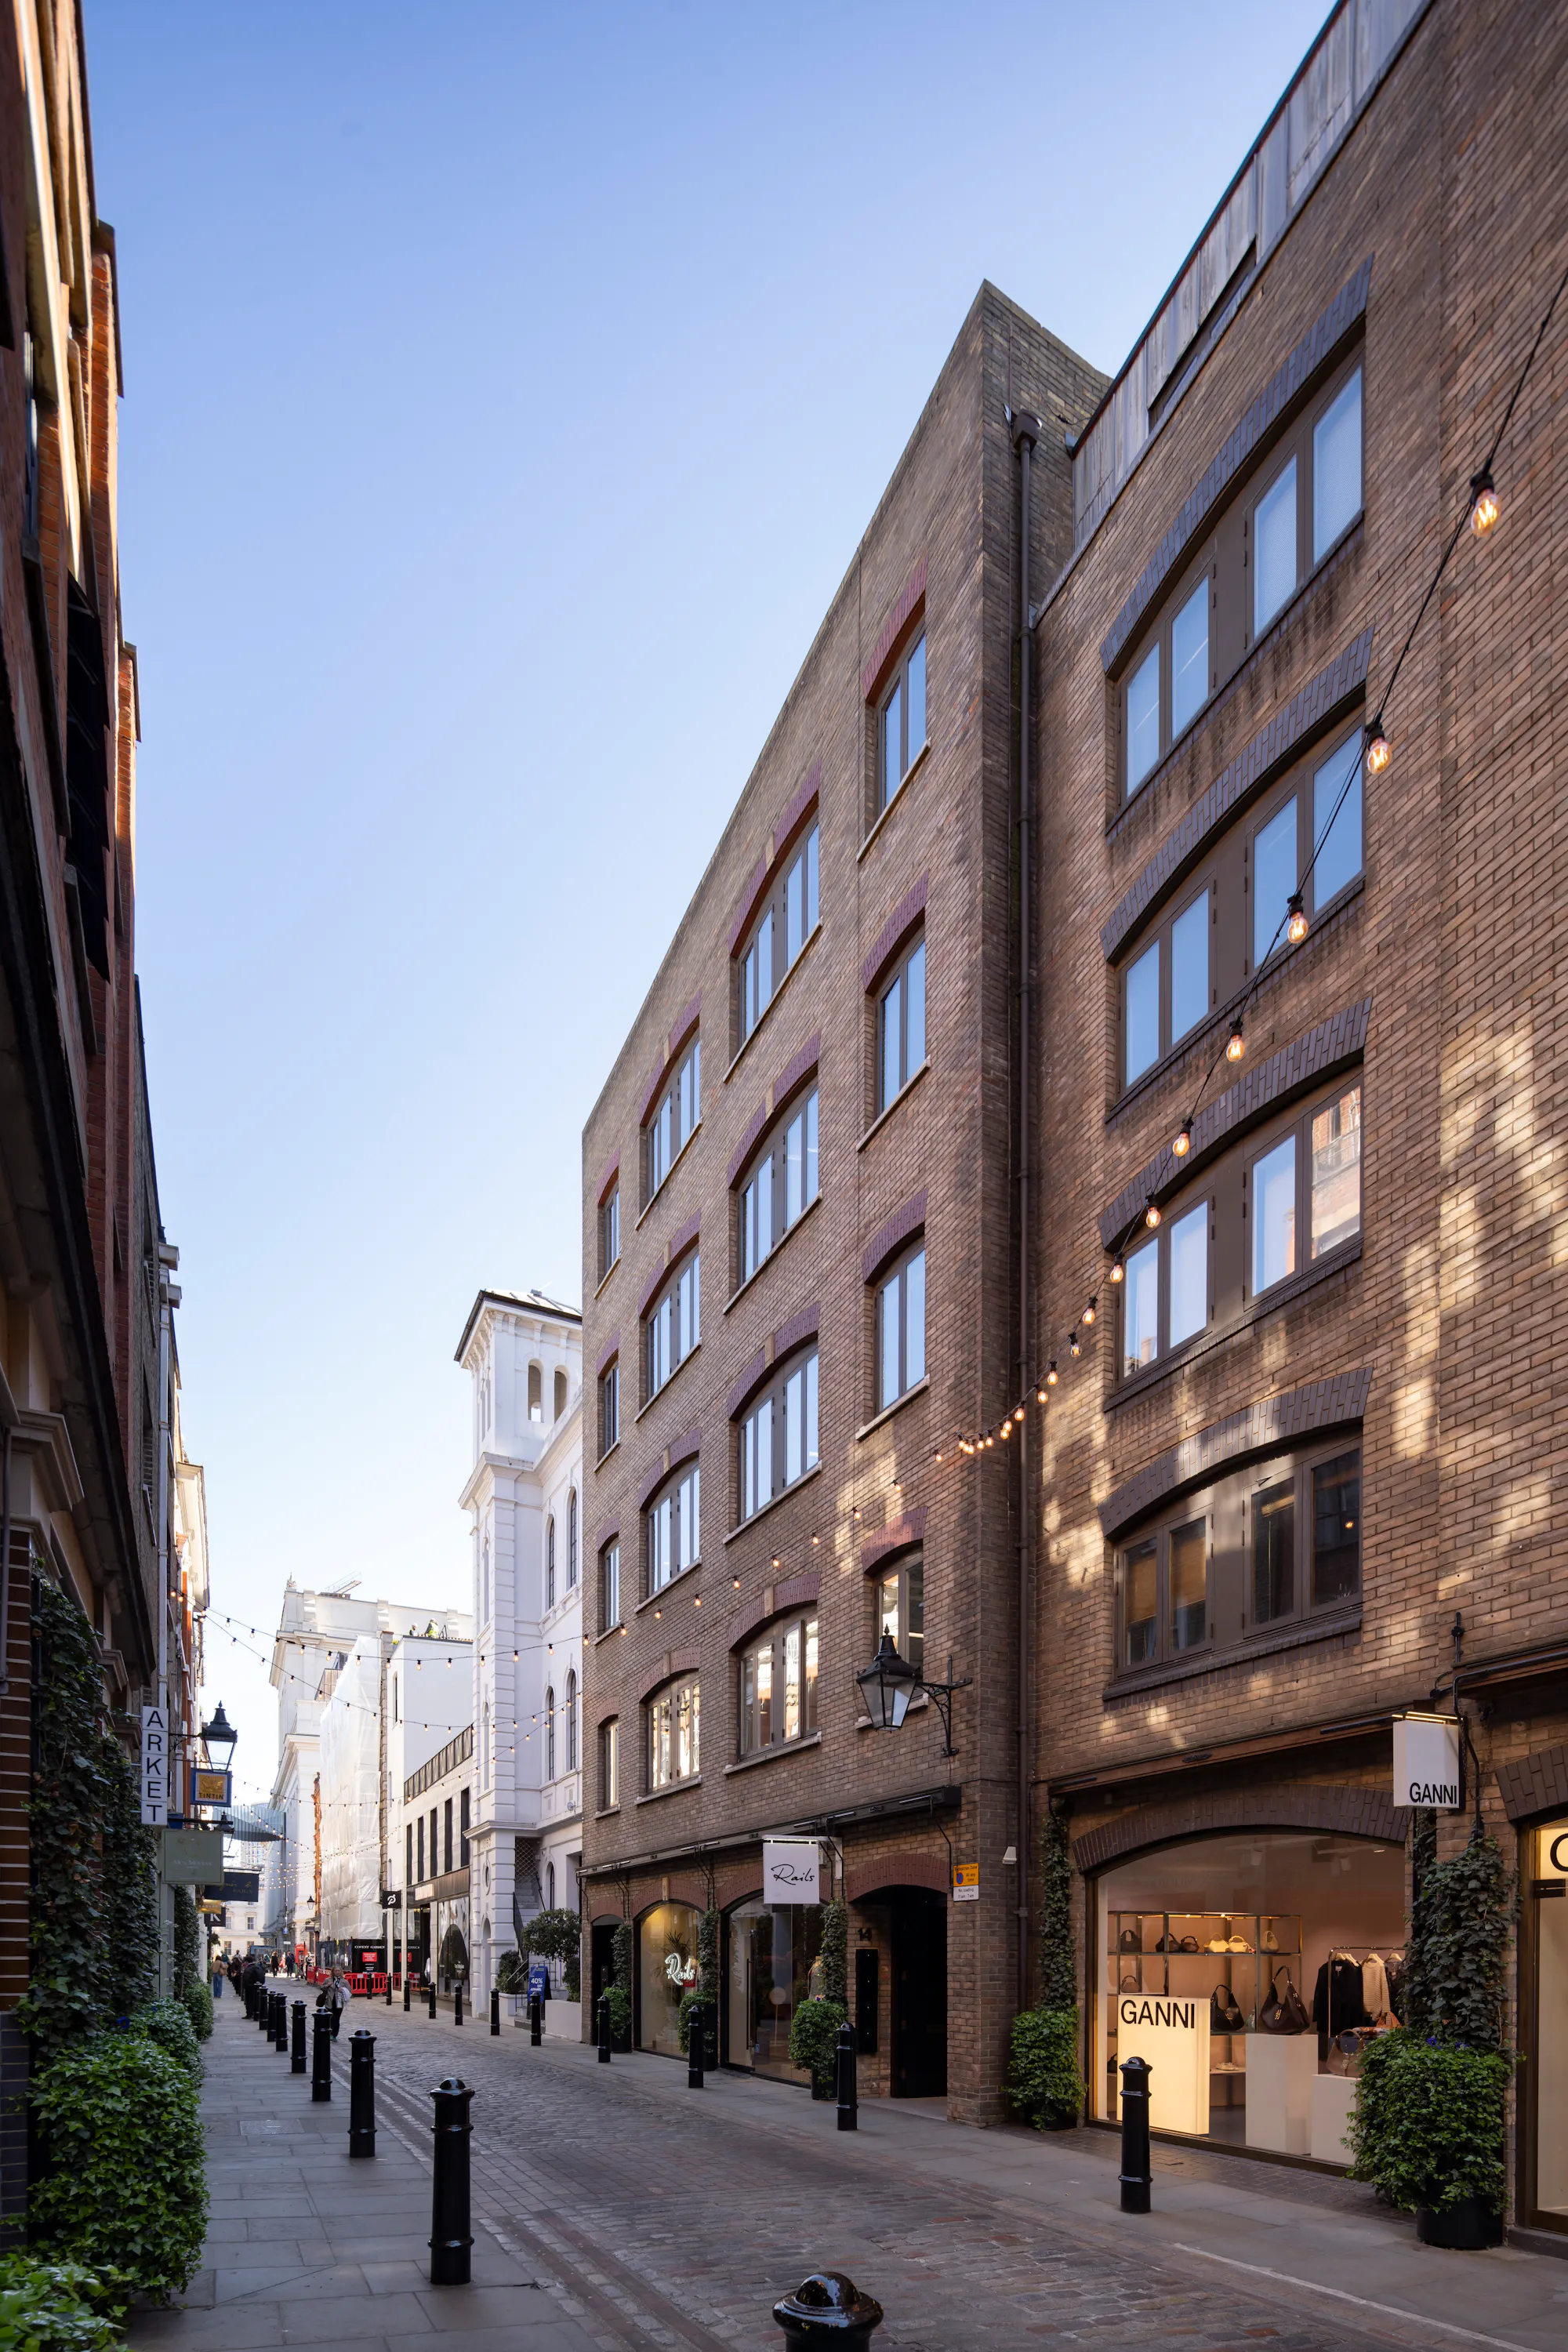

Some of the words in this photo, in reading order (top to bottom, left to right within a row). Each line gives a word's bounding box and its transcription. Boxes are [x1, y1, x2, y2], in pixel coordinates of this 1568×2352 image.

[146, 1710, 164, 1822] ARKET
[1410, 1782, 1457, 1804] GANNI
[771, 1864, 815, 1886] Rails
[858, 1928, 872, 1941] 14
[665, 1952, 695, 1985] Rails
[1121, 1999, 1195, 2028] GANNI
